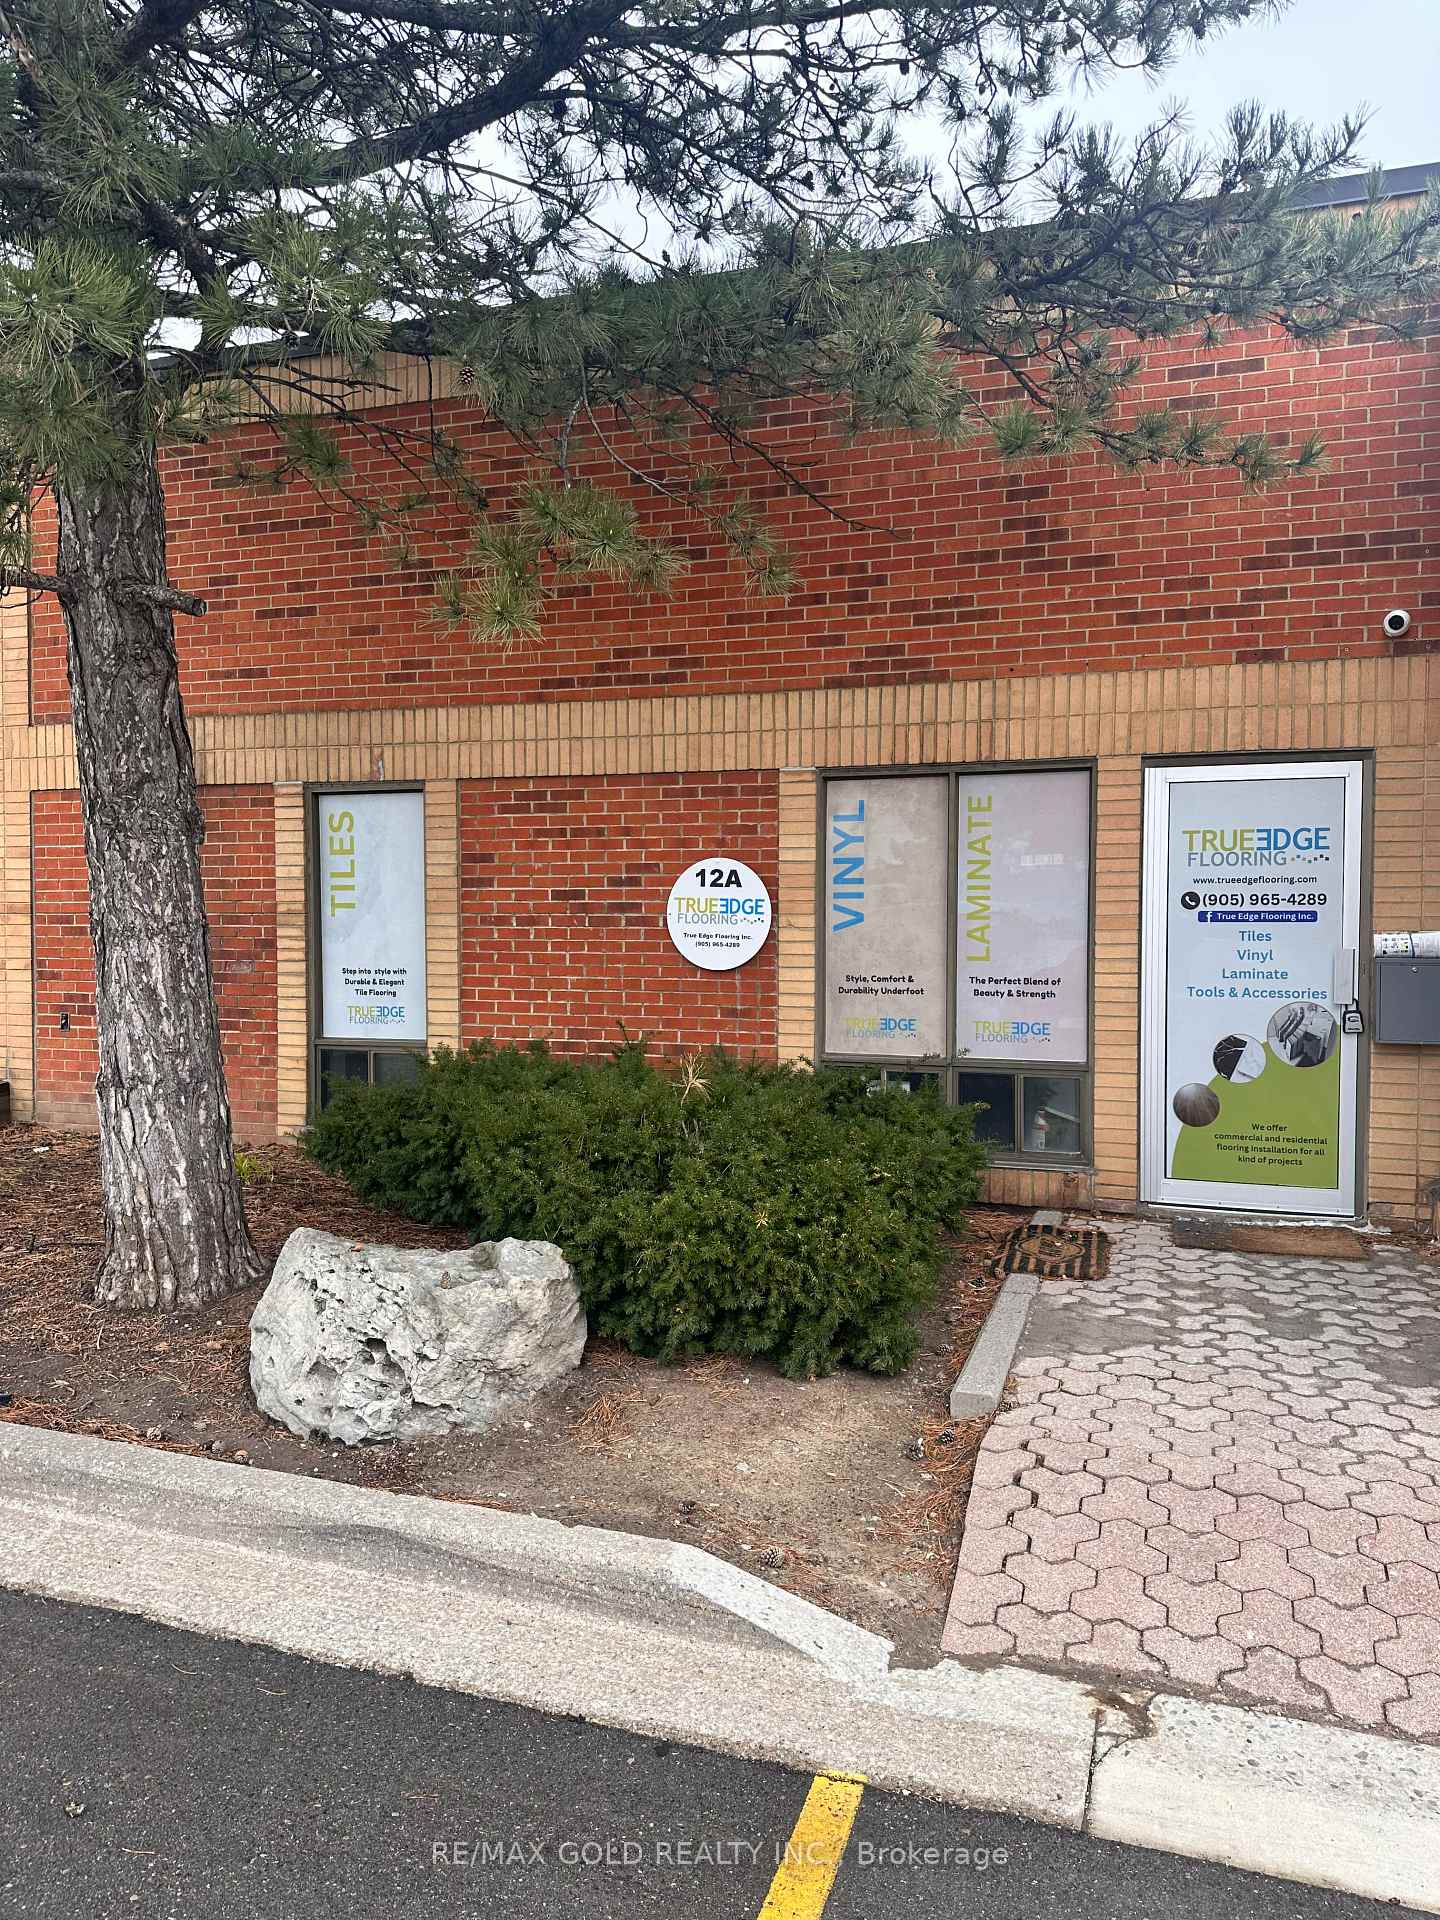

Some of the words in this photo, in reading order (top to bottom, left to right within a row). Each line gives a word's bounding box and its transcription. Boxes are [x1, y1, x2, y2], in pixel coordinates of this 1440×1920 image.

[328, 811, 356, 918] TILES
[1187, 850, 1288, 867] FLOORING
[832, 799, 865, 933] VINYL
[695, 868, 743, 888] 12A
[966, 795, 992, 962] LAMINATE
[1192, 875, 1318, 886] www.trueedgeflooring.com
[1202, 893, 1245, 908] (905)
[1249, 893, 1328, 906] 965-4289
[677, 912, 739, 926] FLOORING
[1216, 912, 1237, 920] True
[1238, 912, 1259, 922] Edge
[1260, 912, 1297, 922] Flooring
[1298, 912, 1315, 921] Inc.
[1238, 930, 1273, 942] Tiles
[1237, 949, 1274, 963] Vinyl
[342, 967, 357, 976] Step
[358, 967, 372, 975] into
[374, 967, 391, 977] style
[392, 967, 407, 975] with
[1222, 968, 1289, 980] Laminate
[378, 978, 405, 987] Elegant
[845, 974, 870, 984] Style,
[870, 975, 906, 983] Comfort
[907, 975, 915, 983] &
[968, 976, 986, 985] The
[988, 976, 1022, 985] Perfect
[1023, 977, 1049, 986] Blend
[1051, 977, 1062, 986] of
[354, 988, 368, 996] Tile
[368, 989, 397, 998] Flooring
[838, 986, 879, 996] Durability
[880, 987, 925, 995] Underfoot
[973, 988, 1005, 999] Beauty
[1006, 989, 1014, 998] &
[1015, 989, 1056, 1000] Strength
[1187, 986, 1225, 998] Tools
[1228, 986, 1239, 998] &
[1242, 987, 1328, 1000] Accessories
[348, 1016, 389, 1025] FLOORING
[975, 1033, 1029, 1043] FLOORING
[1251, 1123, 1265, 1131] We
[1266, 1123, 1288, 1132] offer
[1214, 1132, 1263, 1142] commercial
[1264, 1134, 1281, 1143] and
[1282, 1136, 1328, 1145] residential
[1216, 1143, 1250, 1153] flooring
[1300, 1146, 1313, 1155] for
[1314, 1148, 1325, 1156] all
[1238, 1155, 1256, 1163] kind
[1256, 1155, 1267, 1164] of
[1268, 1157, 1303, 1166] projects
